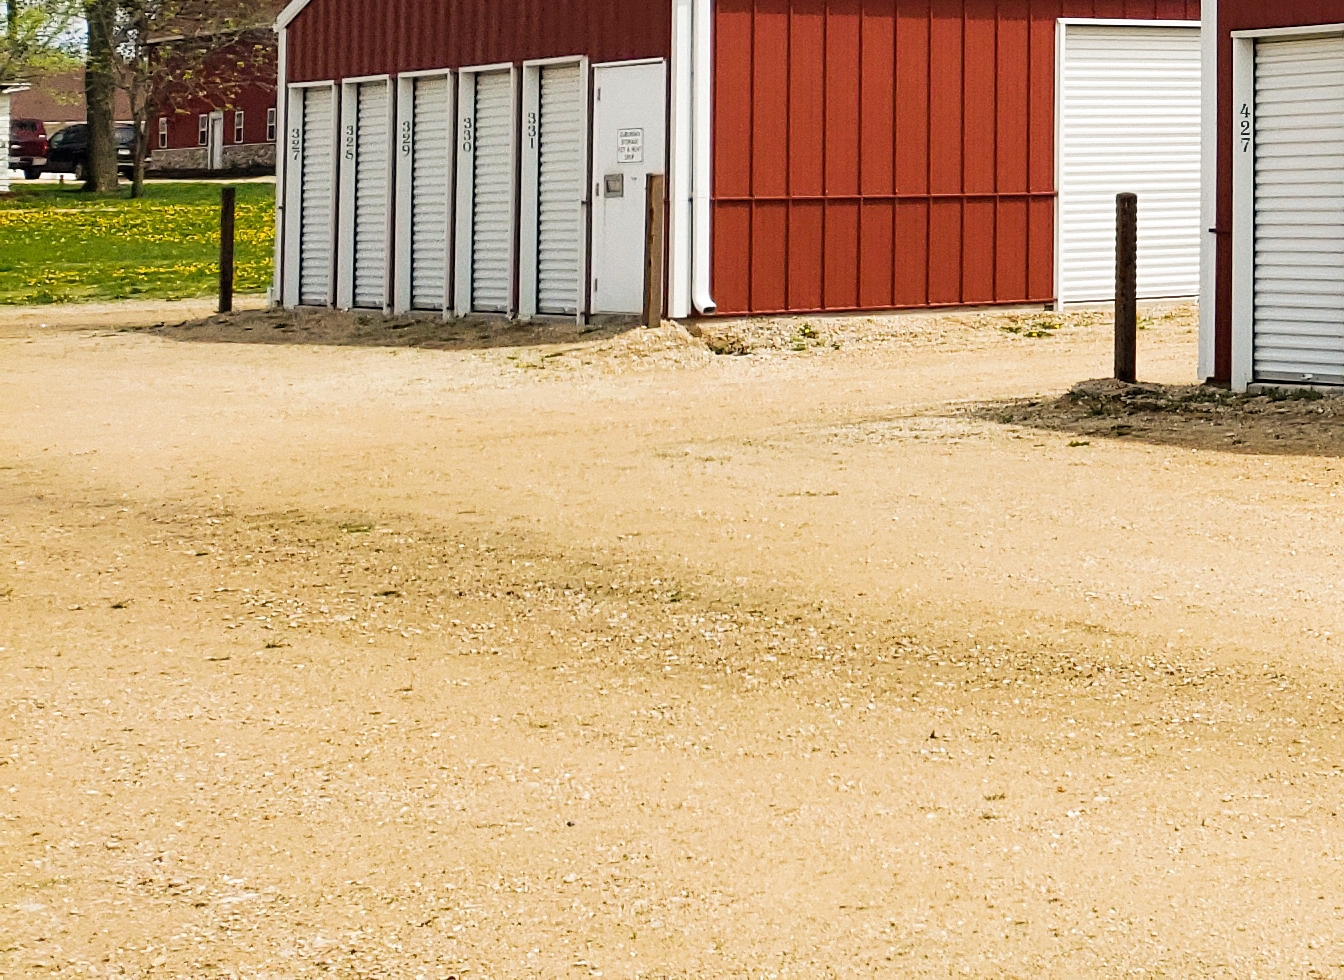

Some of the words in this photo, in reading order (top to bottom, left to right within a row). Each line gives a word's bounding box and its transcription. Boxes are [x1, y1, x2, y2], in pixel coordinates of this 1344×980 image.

[291, 128, 301, 160] 327
[402, 121, 411, 156] 329
[463, 117, 472, 153] 330
[528, 112, 537, 149] 331
[1239, 103, 1251, 153] 427
